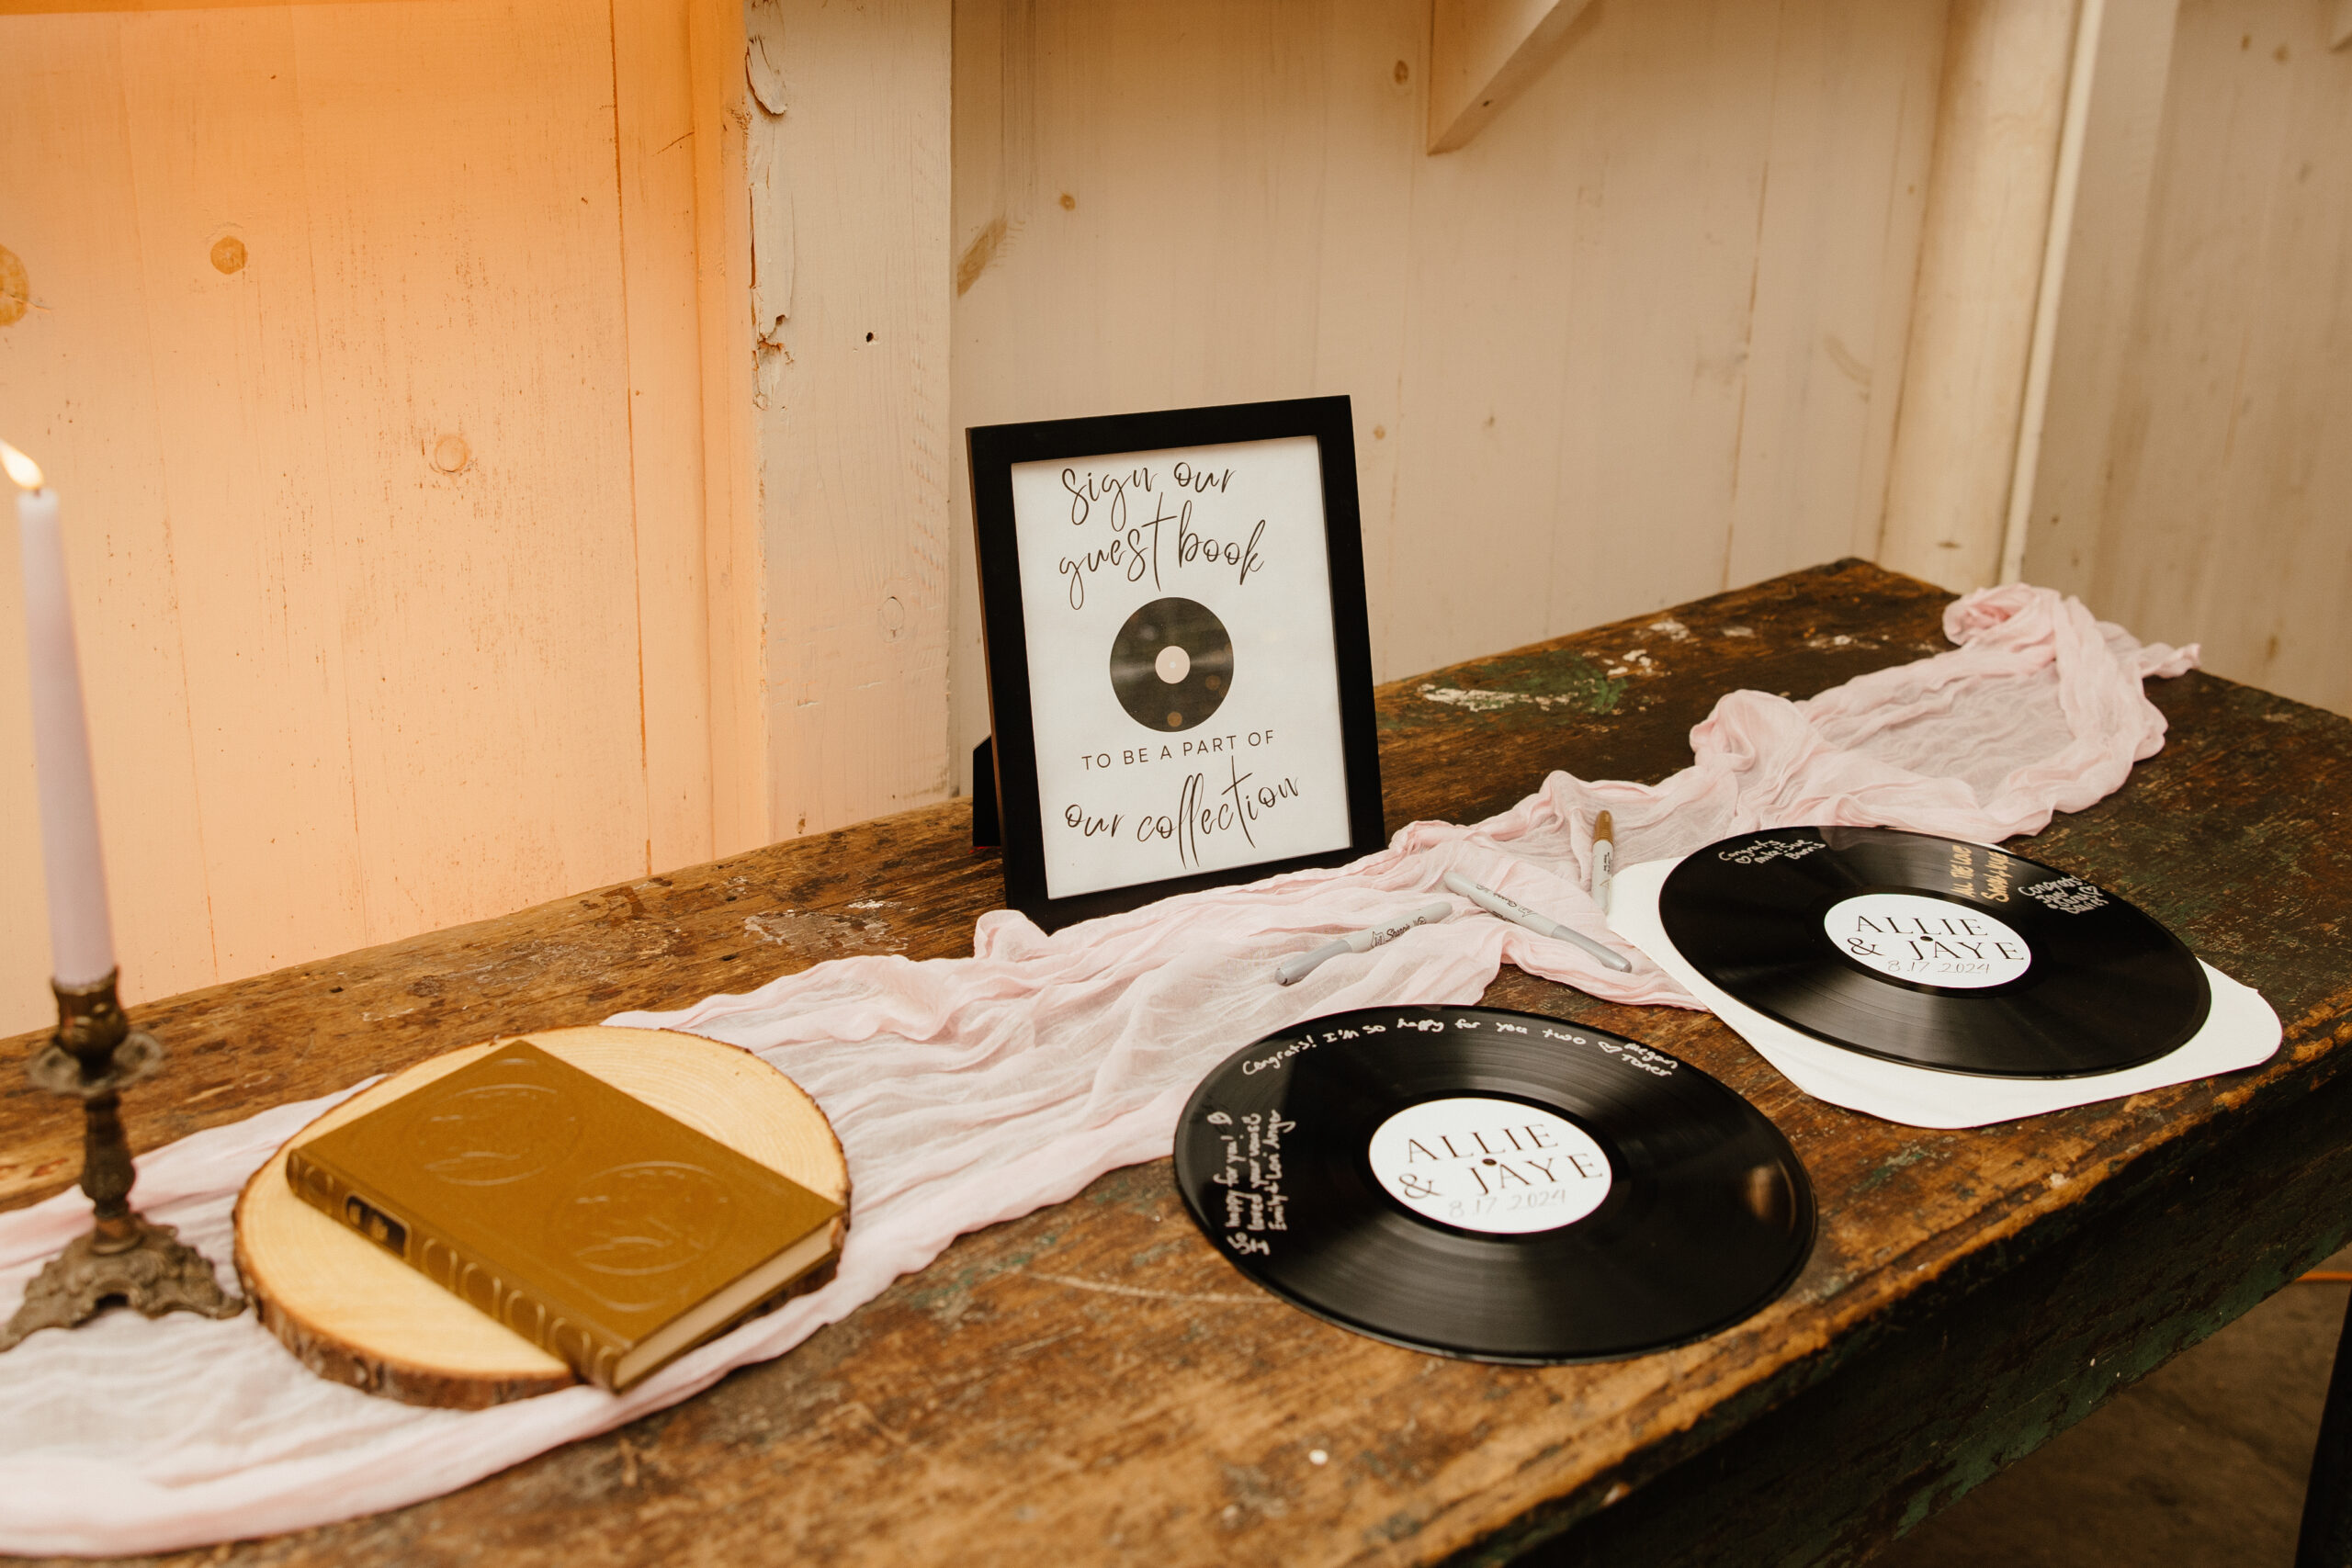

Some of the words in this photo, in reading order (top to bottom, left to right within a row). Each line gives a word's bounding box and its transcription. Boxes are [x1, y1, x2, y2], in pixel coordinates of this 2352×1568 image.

[1174, 462, 1237, 493] our
[1081, 753, 1111, 770] TO
[1124, 748, 1148, 765] BE
[1160, 745, 1172, 760] A
[1183, 735, 1237, 756] PART
[1248, 729, 1274, 747] OF
[1065, 804, 1125, 837] our
[1136, 755, 1299, 870] collection
[1856, 915, 1988, 936] ALLIE
[1847, 938, 1885, 956] &
[1907, 941, 2024, 961] JAYE
[1242, 1034, 1317, 1075] Congrats!
[1397, 1018, 1444, 1032] happy
[1455, 1018, 1480, 1029] for
[1496, 1021, 1528, 1034] you
[1543, 1028, 1587, 1045] two
[1407, 1124, 1558, 1163] ALLIE
[1213, 1166, 1238, 1187] for
[1398, 1173, 1442, 1200] &
[1470, 1153, 1603, 1196] JAYE
